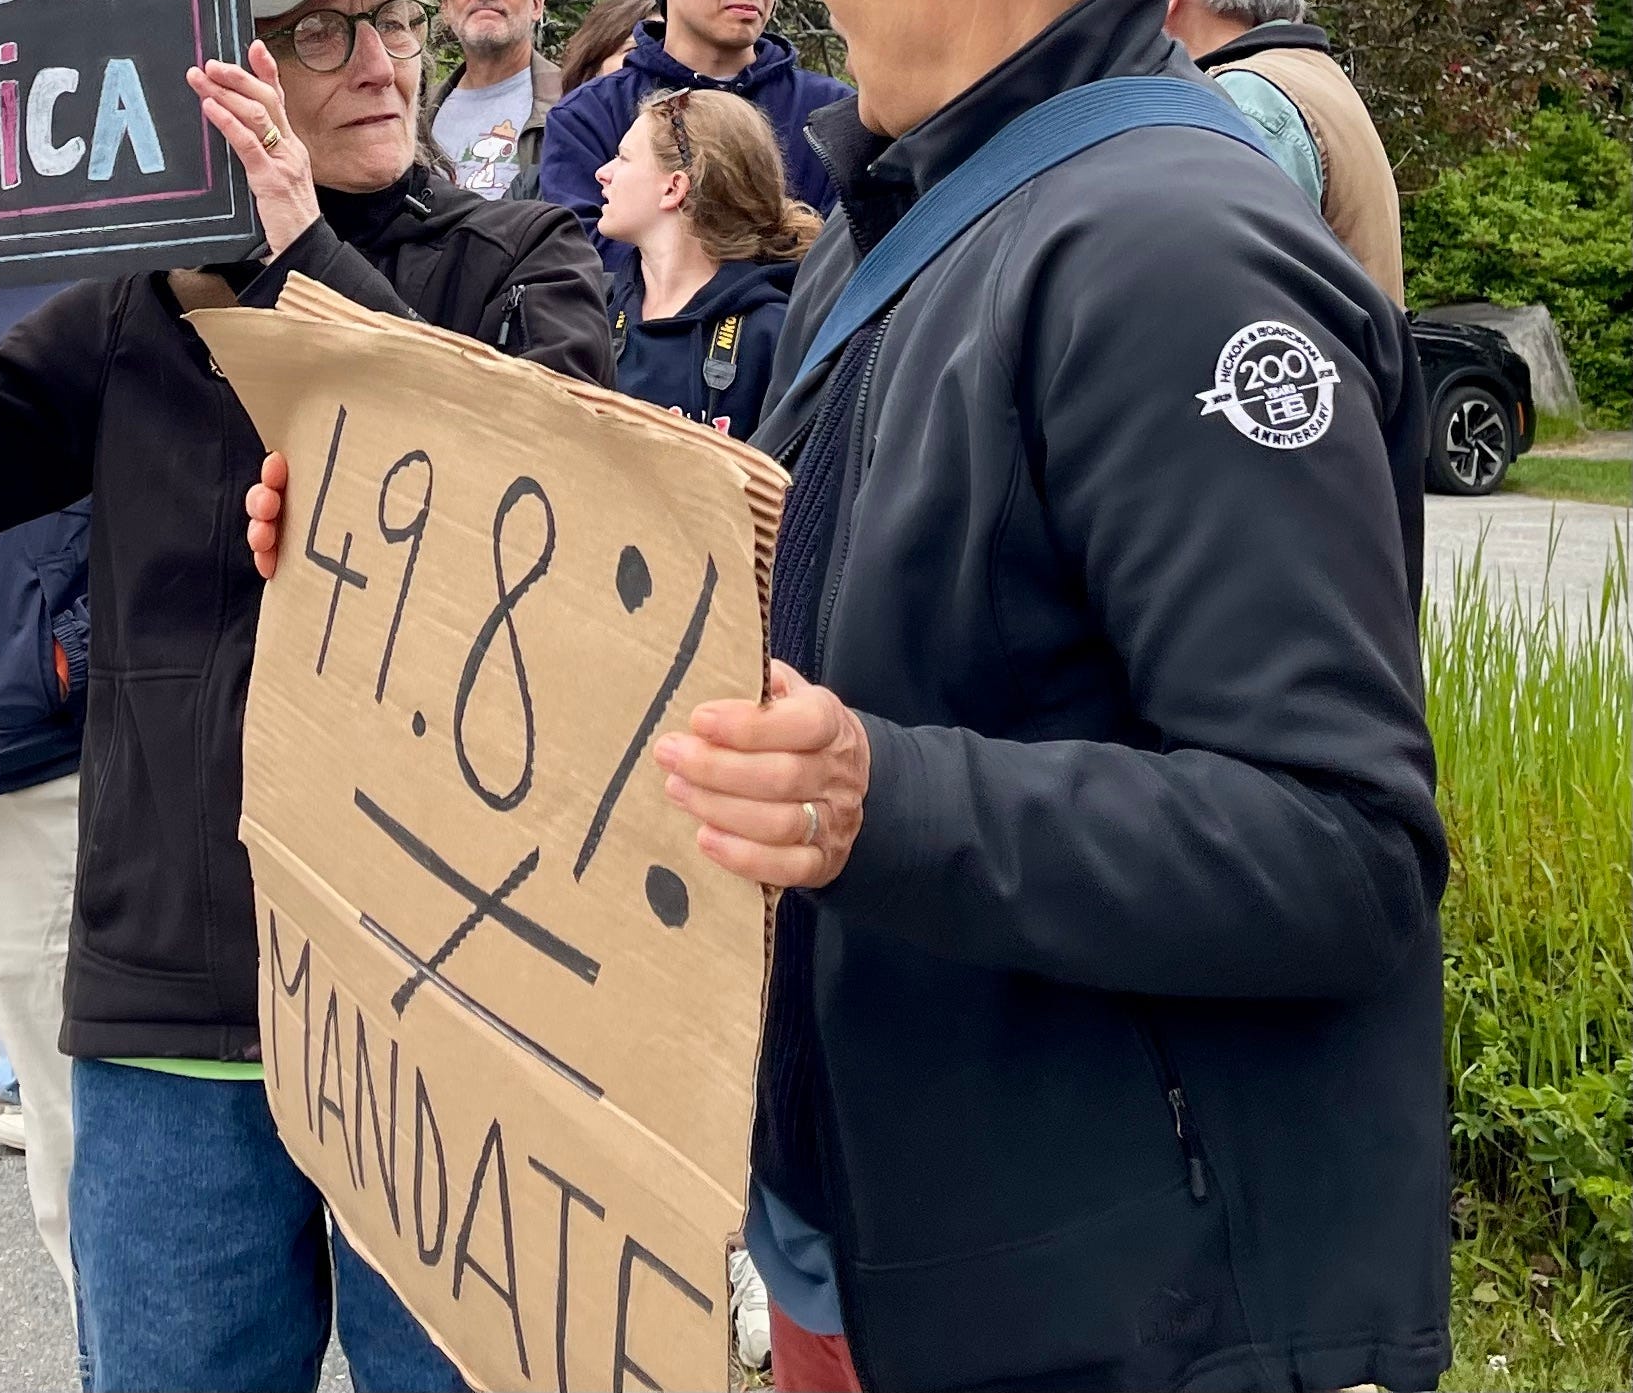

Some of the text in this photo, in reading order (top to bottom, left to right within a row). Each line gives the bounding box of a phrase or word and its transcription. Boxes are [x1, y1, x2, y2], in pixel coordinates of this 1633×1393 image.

[716, 314, 738, 349] Niko
[1239, 349, 1307, 391] 200
[1250, 402, 1329, 446] ANNIVERSARY
[268, 909, 714, 1393] MANDATE
